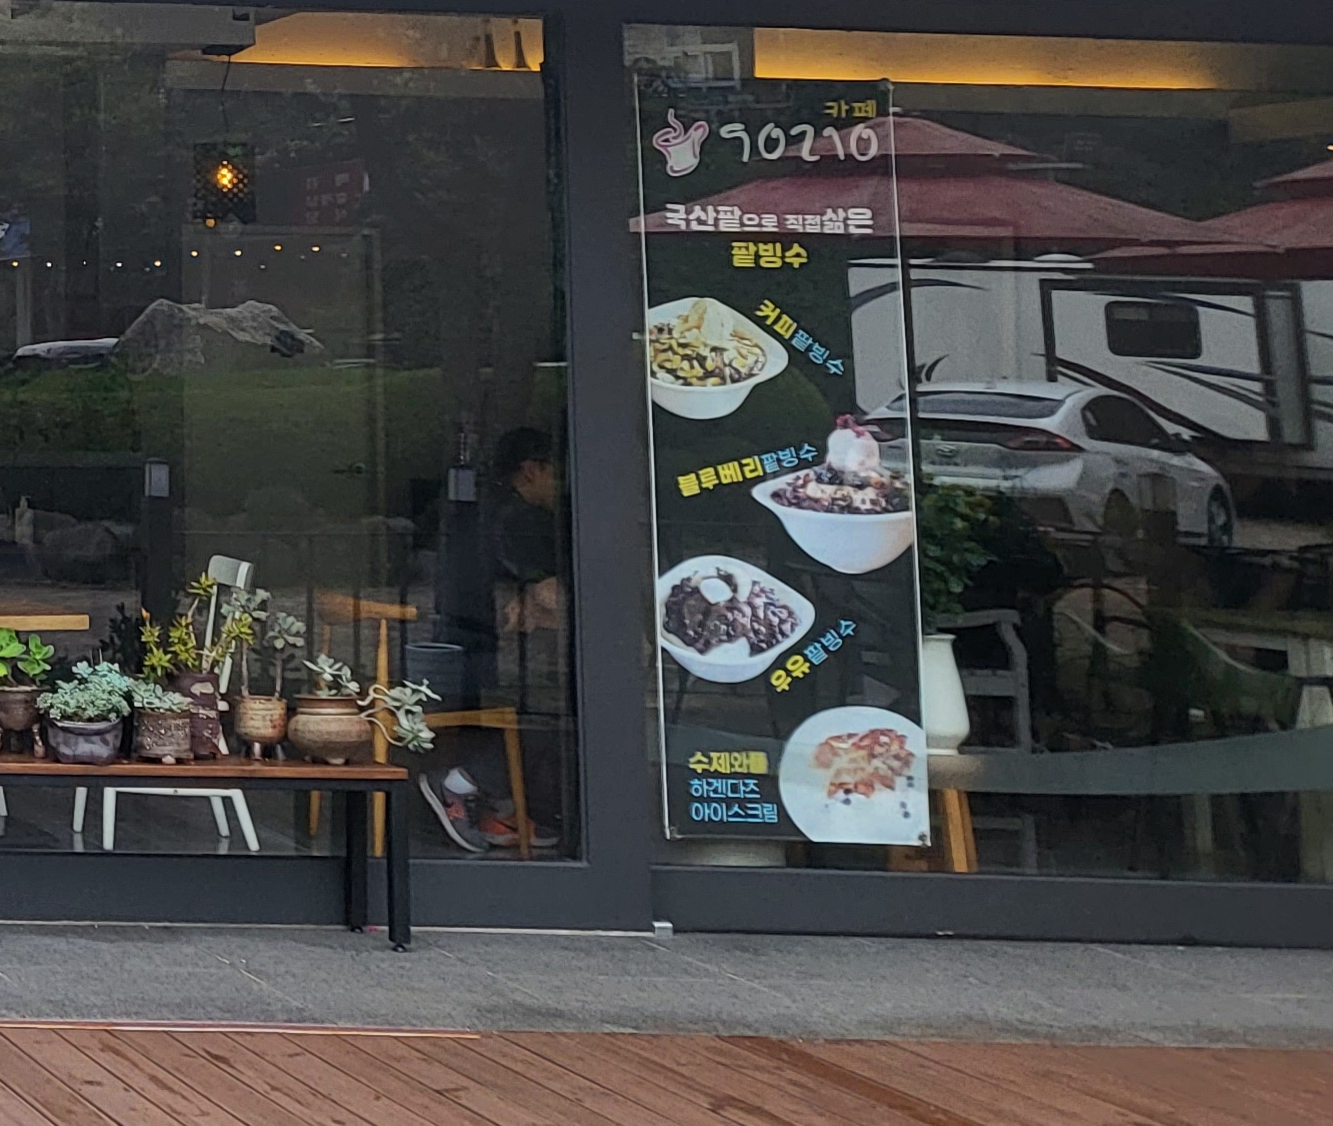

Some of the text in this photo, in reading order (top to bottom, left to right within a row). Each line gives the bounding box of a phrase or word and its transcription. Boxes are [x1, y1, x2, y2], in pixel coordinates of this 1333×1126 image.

[824, 100, 877, 119] 카페
[719, 123, 879, 162] 90210
[665, 203, 779, 232] 국산팥으로
[731, 241, 808, 268] 팥빙수
[689, 778, 761, 798] 하겐다즈
[690, 802, 778, 823] 아이스크림
